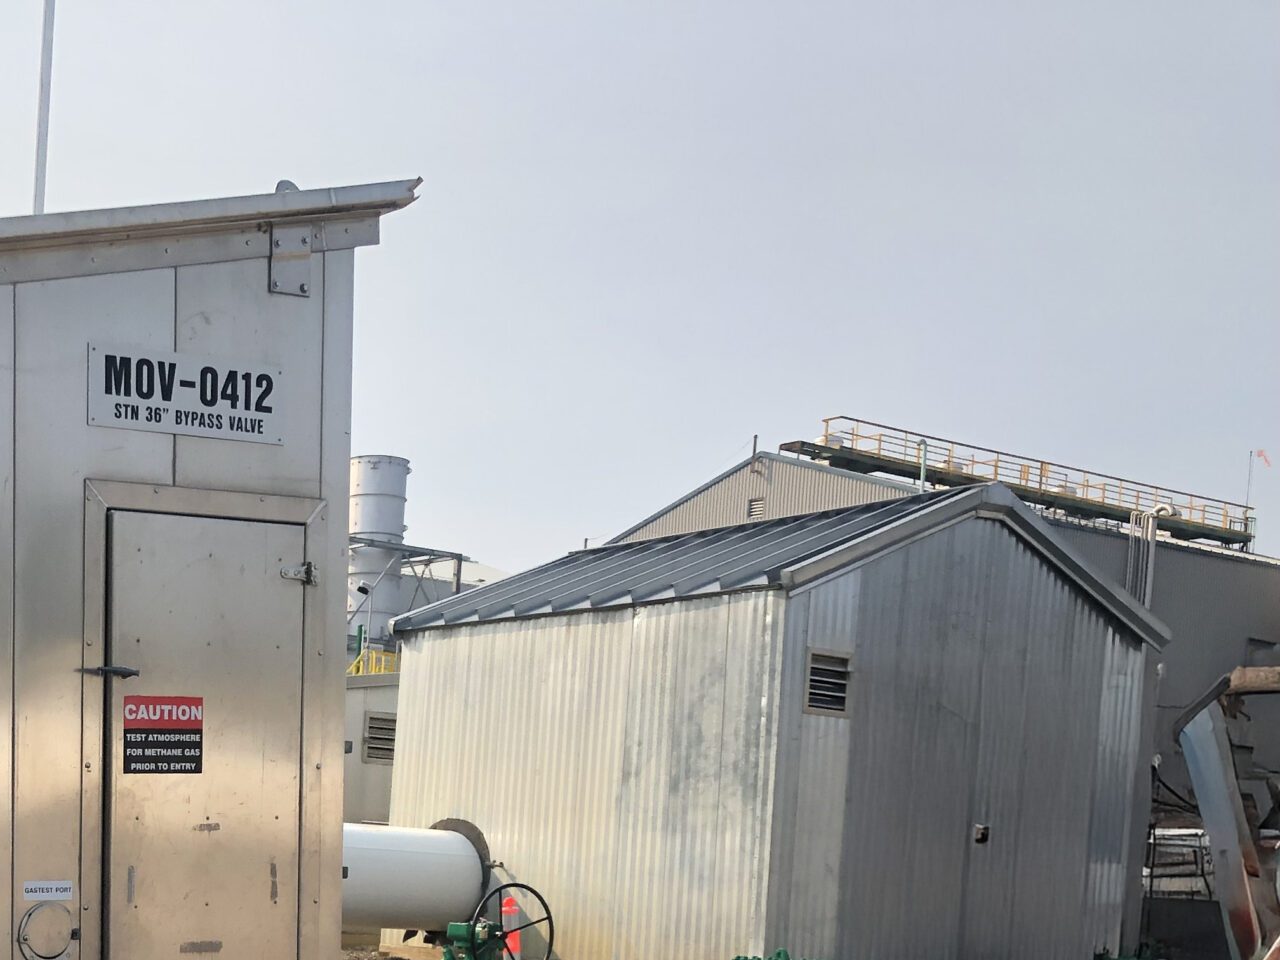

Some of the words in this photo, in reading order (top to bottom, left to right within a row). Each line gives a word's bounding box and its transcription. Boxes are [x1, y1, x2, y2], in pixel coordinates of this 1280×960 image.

[105, 354, 273, 413] MOV-0412
[115, 403, 139, 421] STN
[175, 410, 222, 429] BYPASS
[229, 416, 263, 434] VALVE
[124, 704, 202, 720] CAUTION
